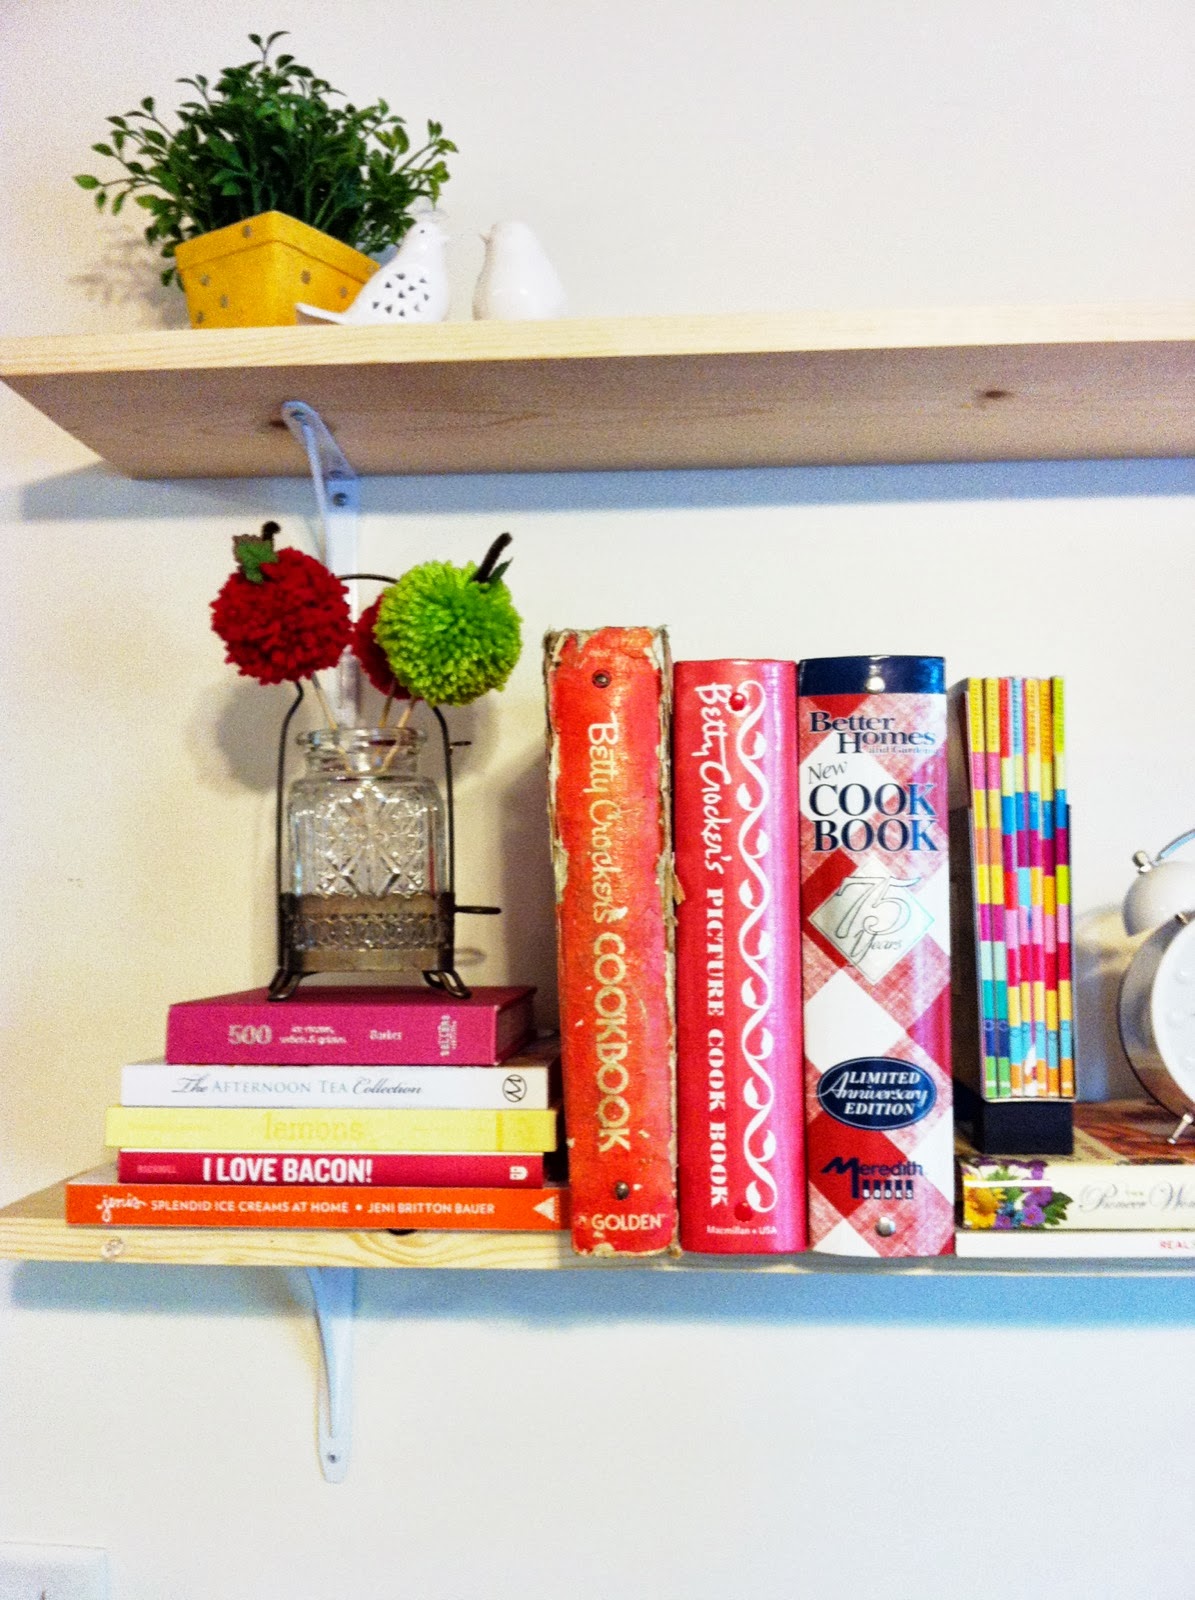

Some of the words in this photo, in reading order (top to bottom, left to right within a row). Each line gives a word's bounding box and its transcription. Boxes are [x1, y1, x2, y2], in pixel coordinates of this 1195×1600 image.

[690, 682, 733, 757] Betty
[809, 711, 895, 732] Better
[583, 711, 619, 793] Betty
[837, 731, 936, 754] Homes
[807, 761, 848, 784] New
[699, 752, 732, 875] Crocker's
[808, 783, 936, 817] COOK
[812, 819, 939, 852] BOOK
[835, 876, 921, 939] 75
[706, 888, 725, 1016] PICTURE
[228, 1024, 272, 1045] 500
[593, 931, 631, 1152] COOKBOOK
[171, 1073, 209, 1094] The
[211, 1080, 310, 1094] AFTERNOON
[320, 1080, 348, 1093] TEA
[352, 1076, 422, 1094] Collection
[708, 1029, 726, 1112] COOK
[850, 1071, 921, 1084] LIMITED
[816, 1071, 928, 1108] Anniversary
[844, 1102, 916, 1115] EDITION
[262, 1112, 363, 1141] lemons
[203, 1158, 211, 1181] I
[217, 1158, 276, 1182] LOVE
[282, 1158, 373, 1184] BACON!
[709, 1122, 728, 1207] BOOK
[821, 1157, 924, 1199] Meredith
[151, 1200, 212, 1211] SPLENDID
[215, 1201, 235, 1212] ICE
[238, 1201, 289, 1212] CREAMS
[291, 1201, 308, 1212] AT
[310, 1201, 349, 1213] HOME
[367, 1203, 395, 1213] JENI
[397, 1203, 451, 1214] BRITTON
[455, 1203, 495, 1214] BAUER
[863, 1189, 914, 1199] BOOKS
[591, 1214, 662, 1231] GOLDEN
[706, 1225, 750, 1235] Macmillan
[758, 1225, 777, 1235] USA
